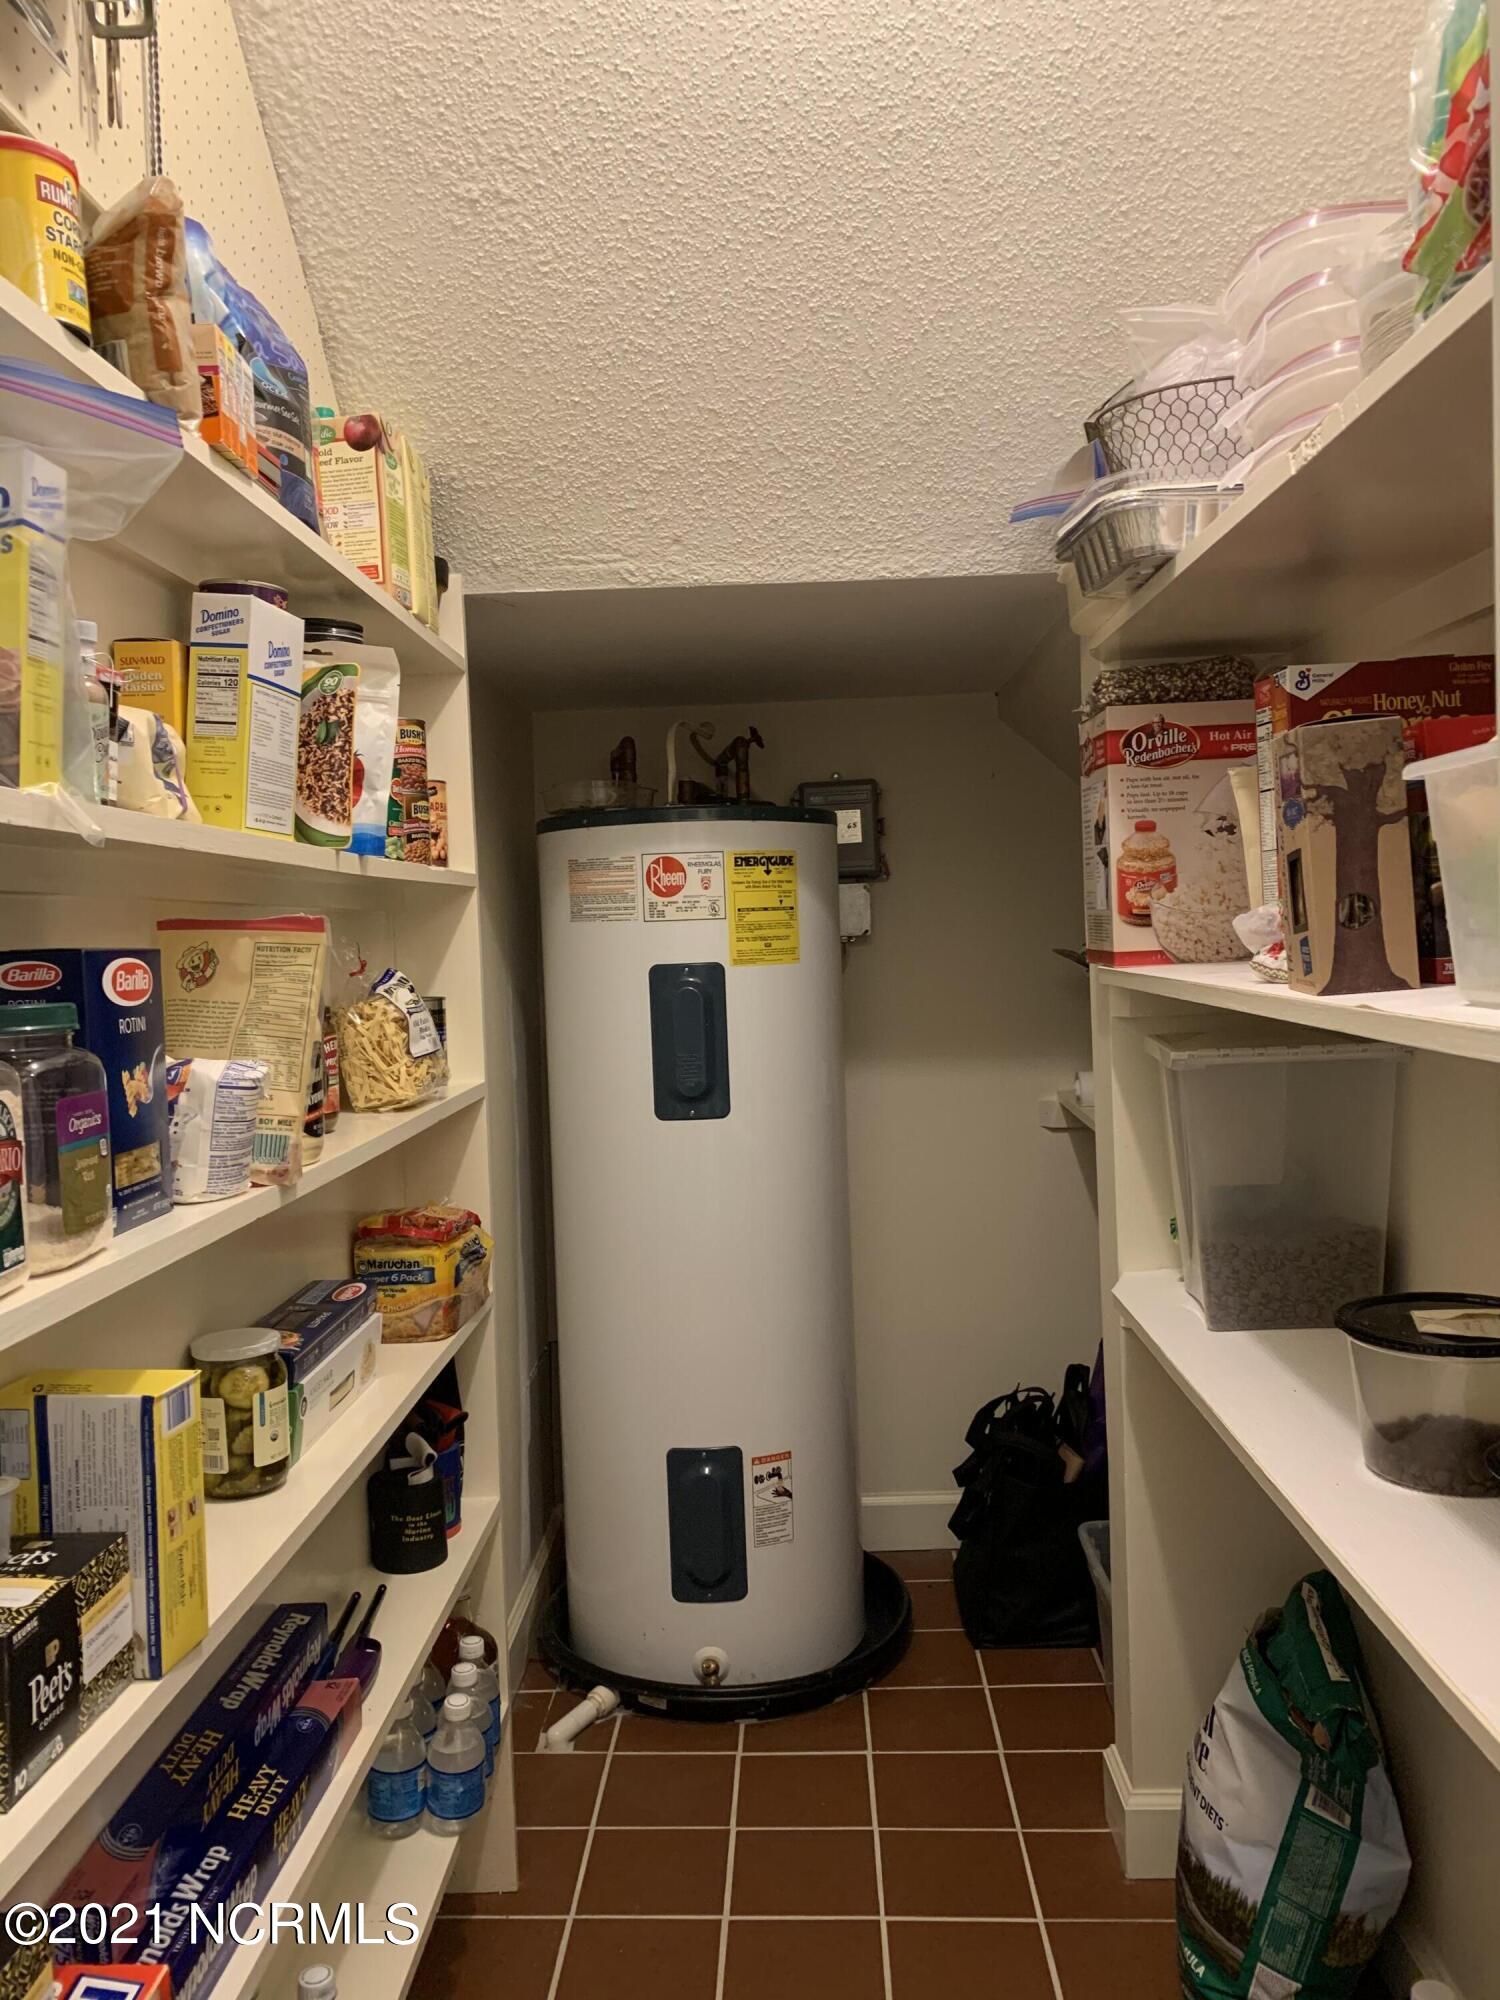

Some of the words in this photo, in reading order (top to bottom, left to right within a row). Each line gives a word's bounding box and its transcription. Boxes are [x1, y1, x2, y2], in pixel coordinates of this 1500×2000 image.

[40, 180, 79, 215] RUMF
[53, 211, 81, 237] COR
[46, 225, 83, 251] STAR
[318, 448, 333, 457] old
[319, 457, 333, 466] eef
[335, 455, 364, 466] Flavor
[322, 507, 339, 516] OOD
[200, 606, 240, 625] Domino
[195, 618, 245, 634] CONFECTIONERS
[211, 627, 231, 637] SUGAR
[268, 640, 291, 659] Domino
[197, 655, 222, 663] Nutrition
[223, 655, 240, 664] Facts
[197, 679, 221, 687] Calories
[223, 678, 239, 687] 120
[324, 677, 339, 688] 90
[1373, 693, 1425, 711] Honey
[1431, 690, 1463, 708] Nut
[1131, 728, 1188, 752] Orville
[1209, 730, 1231, 741] Hot
[1233, 730, 1251, 740] Air
[1123, 743, 1198, 768] Redenbacher's
[1230, 743, 1257, 752] PRE
[413, 803, 430, 816] BUSH
[650, 858, 686, 893] Rheem
[256, 945, 291, 954] NUTRITION
[7, 967, 55, 983] Barilla
[115, 968, 150, 992] Barilla
[118, 1016, 147, 1035] ROTINI
[68, 1112, 102, 1135] Organics
[258, 1117, 274, 1126] BOY
[0, 1146, 21, 1173] RIO
[367, 1258, 420, 1270] Maruchan
[390, 1272, 399, 1282] 6
[400, 1273, 425, 1283] Pack
[761, 1452, 791, 1465] DANGER
[401, 1533, 435, 1543] Industry
[404, 1527, 432, 1536] Marine
[253, 1611, 312, 1675] Reynolds
[28, 1661, 73, 1727] Peet's
[219, 1664, 271, 1711] Wrap
[38, 1701, 66, 1732] COFFEE
[159, 1732, 197, 1774] DUTY
[170, 1728, 225, 1787] HEAVY
[14, 1768, 27, 1796] 10
[226, 1763, 279, 1821] HEAVY
[253, 1774, 290, 1816] DUTY
[1199, 1796, 1225, 1832] DIETS
[170, 1845, 232, 1902] Wrap
